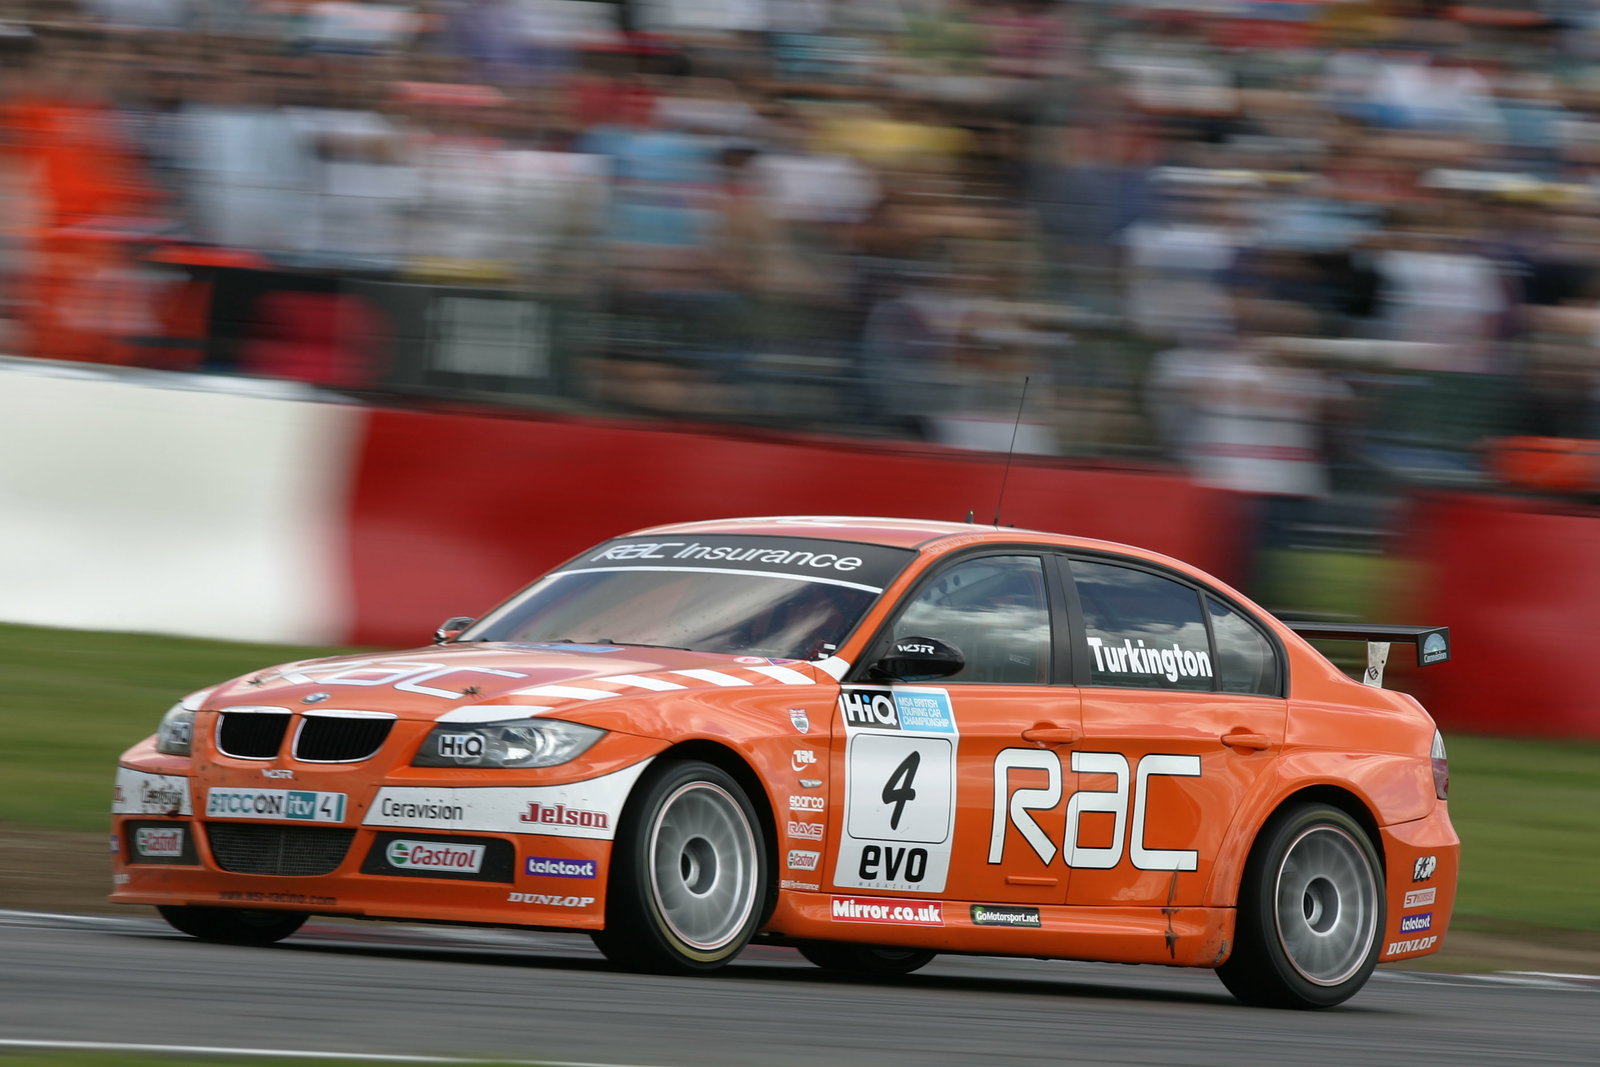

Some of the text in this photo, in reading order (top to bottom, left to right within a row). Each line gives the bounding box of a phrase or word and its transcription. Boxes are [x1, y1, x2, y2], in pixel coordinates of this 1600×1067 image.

[678, 542, 863, 571] Insurance
[897, 644, 935, 655] WSR
[1087, 637, 1213, 682] Turkington
[842, 692, 898, 726] HiQ
[900, 706, 942, 717] TOURING CAR
[913, 698, 938, 708] BRITISH
[903, 716, 949, 727] CHAMPIONSHIP
[441, 736, 483, 757] HiQ
[882, 750, 920, 831] 4
[381, 798, 463, 820] Ceravision
[789, 795, 824, 809] sparco
[520, 802, 609, 829] Jelson
[788, 821, 824, 836] RAYS
[411, 845, 475, 868] Castrol
[794, 852, 817, 868] Castrol
[859, 844, 928, 883] evo
[528, 858, 594, 876] teletext
[507, 892, 595, 907] DUNLOP
[832, 899, 942, 923] Mirror.co.uk
[976, 910, 1039, 924] GoMotorsport.net
[1402, 914, 1430, 932] teletext
[1386, 936, 1438, 955] DUNLOP
